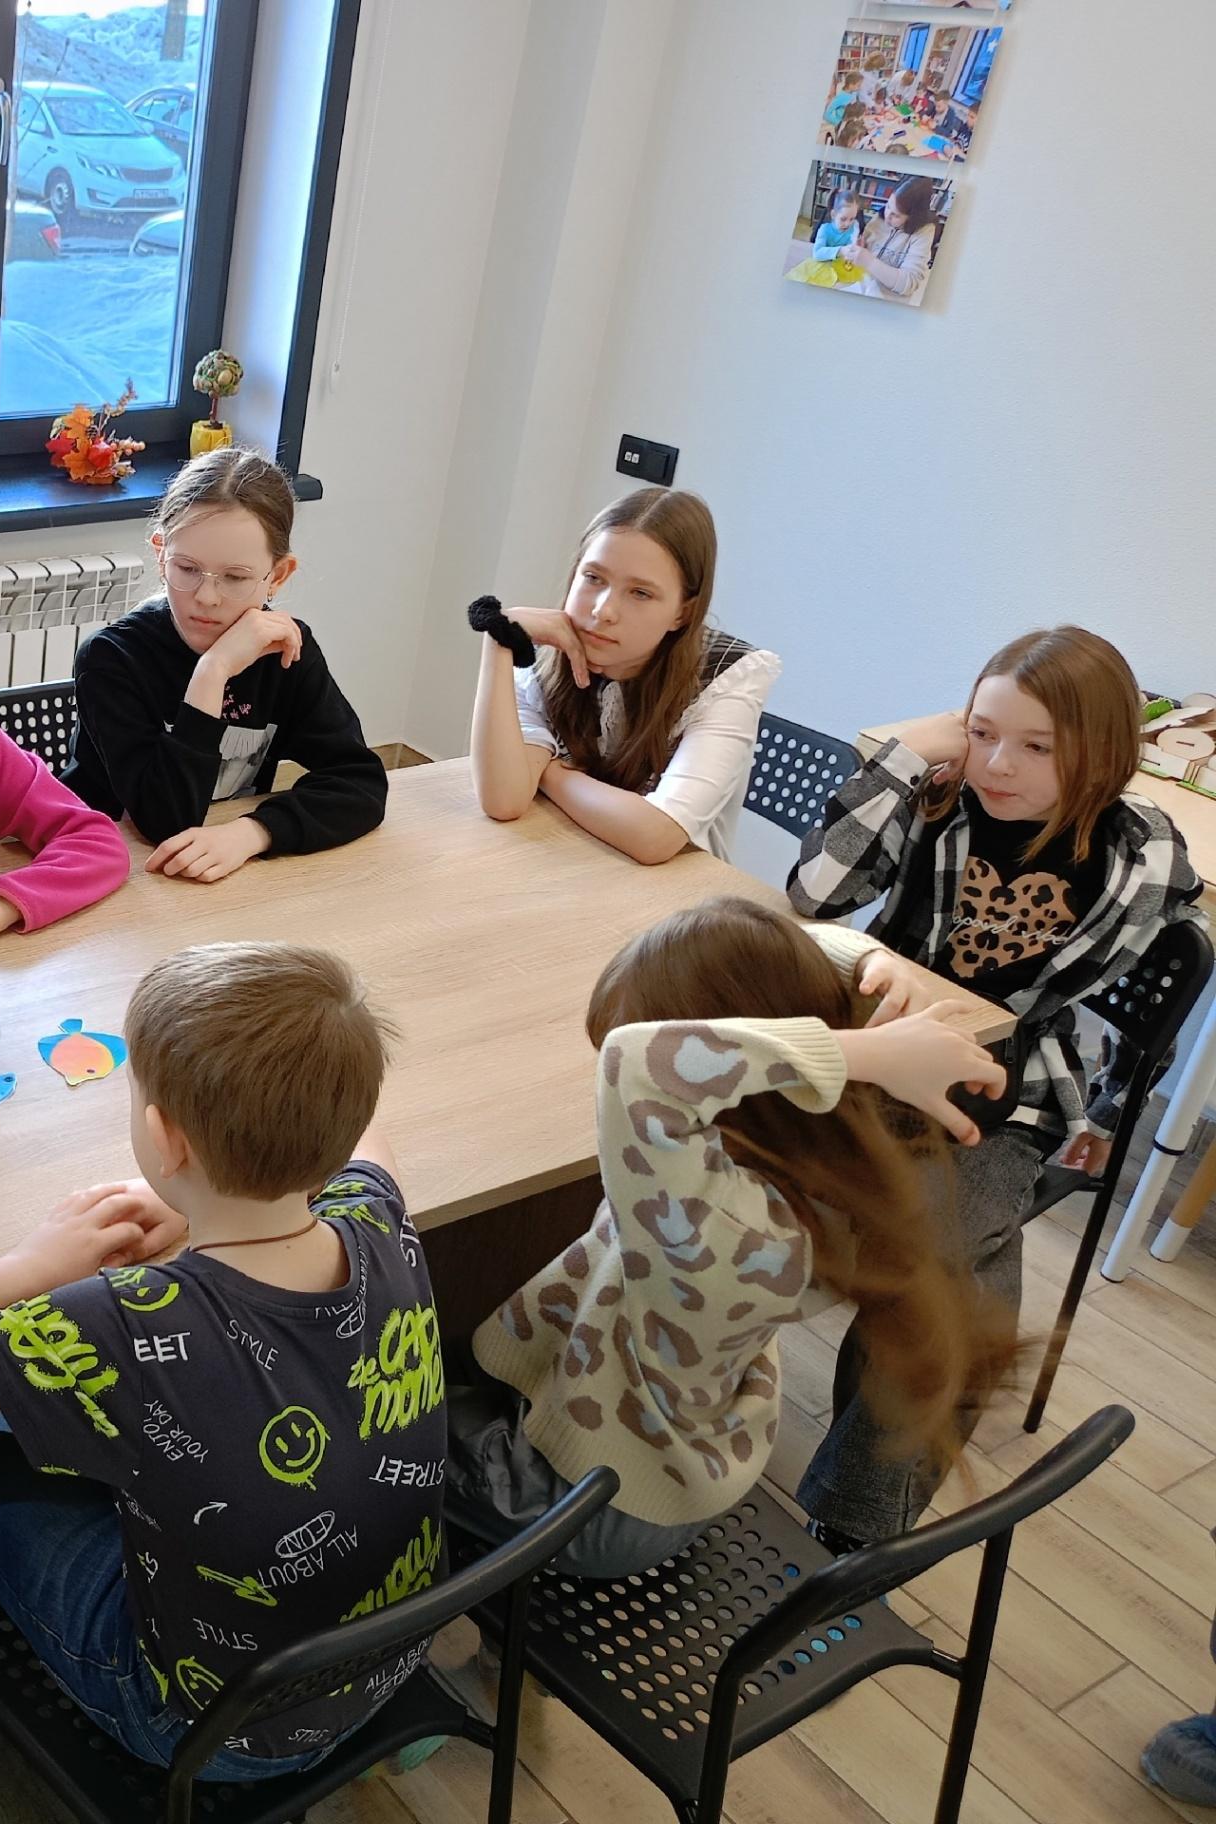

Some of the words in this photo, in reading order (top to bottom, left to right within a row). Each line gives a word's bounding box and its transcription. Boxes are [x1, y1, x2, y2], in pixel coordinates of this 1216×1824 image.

[226, 1319, 279, 1371] STYLE
[144, 1399, 173, 1425] DAY
[143, 1418, 184, 1462] ENJO
[170, 1423, 209, 1464] YOUR
[368, 1455, 446, 1488] STREET
[284, 1516, 328, 1554] FUN
[327, 1523, 358, 1557] ALL
[257, 1547, 325, 1588] ABOUT
[192, 1617, 258, 1651] STYLE
